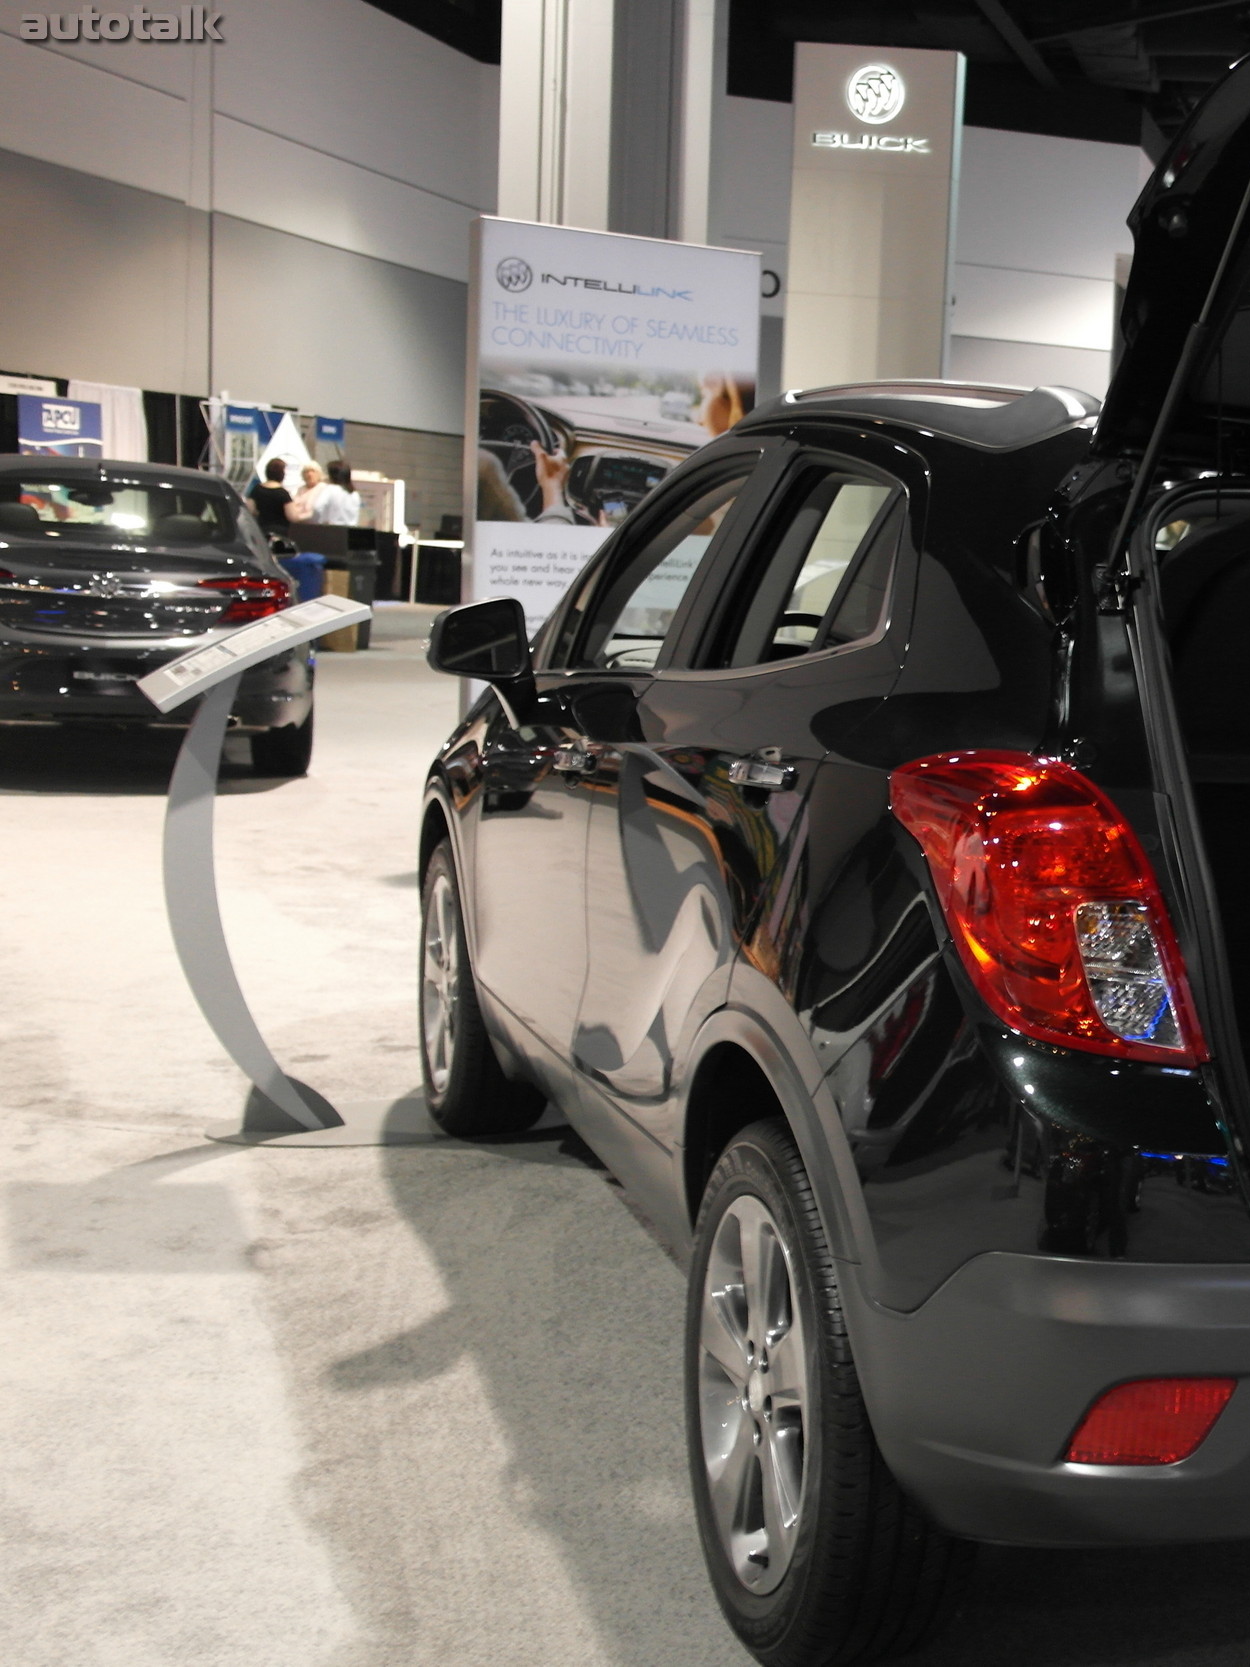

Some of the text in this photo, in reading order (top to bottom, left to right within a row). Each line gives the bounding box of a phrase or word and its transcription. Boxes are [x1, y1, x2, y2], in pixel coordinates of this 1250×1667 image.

[812, 132, 931, 154] BUICK
[492, 301, 740, 347] THE LUXURY OF SEAMLESS
[491, 326, 644, 359] CONNECTIVITY
[490, 548, 503, 558] As
[506, 549, 544, 560] intuitive
[546, 552, 558, 560] as
[489, 565, 508, 575] you
[512, 565, 528, 573] see
[530, 563, 550, 574] and
[553, 564, 575, 575] hear
[489, 576, 520, 587] whole
[522, 578, 543, 588] new
